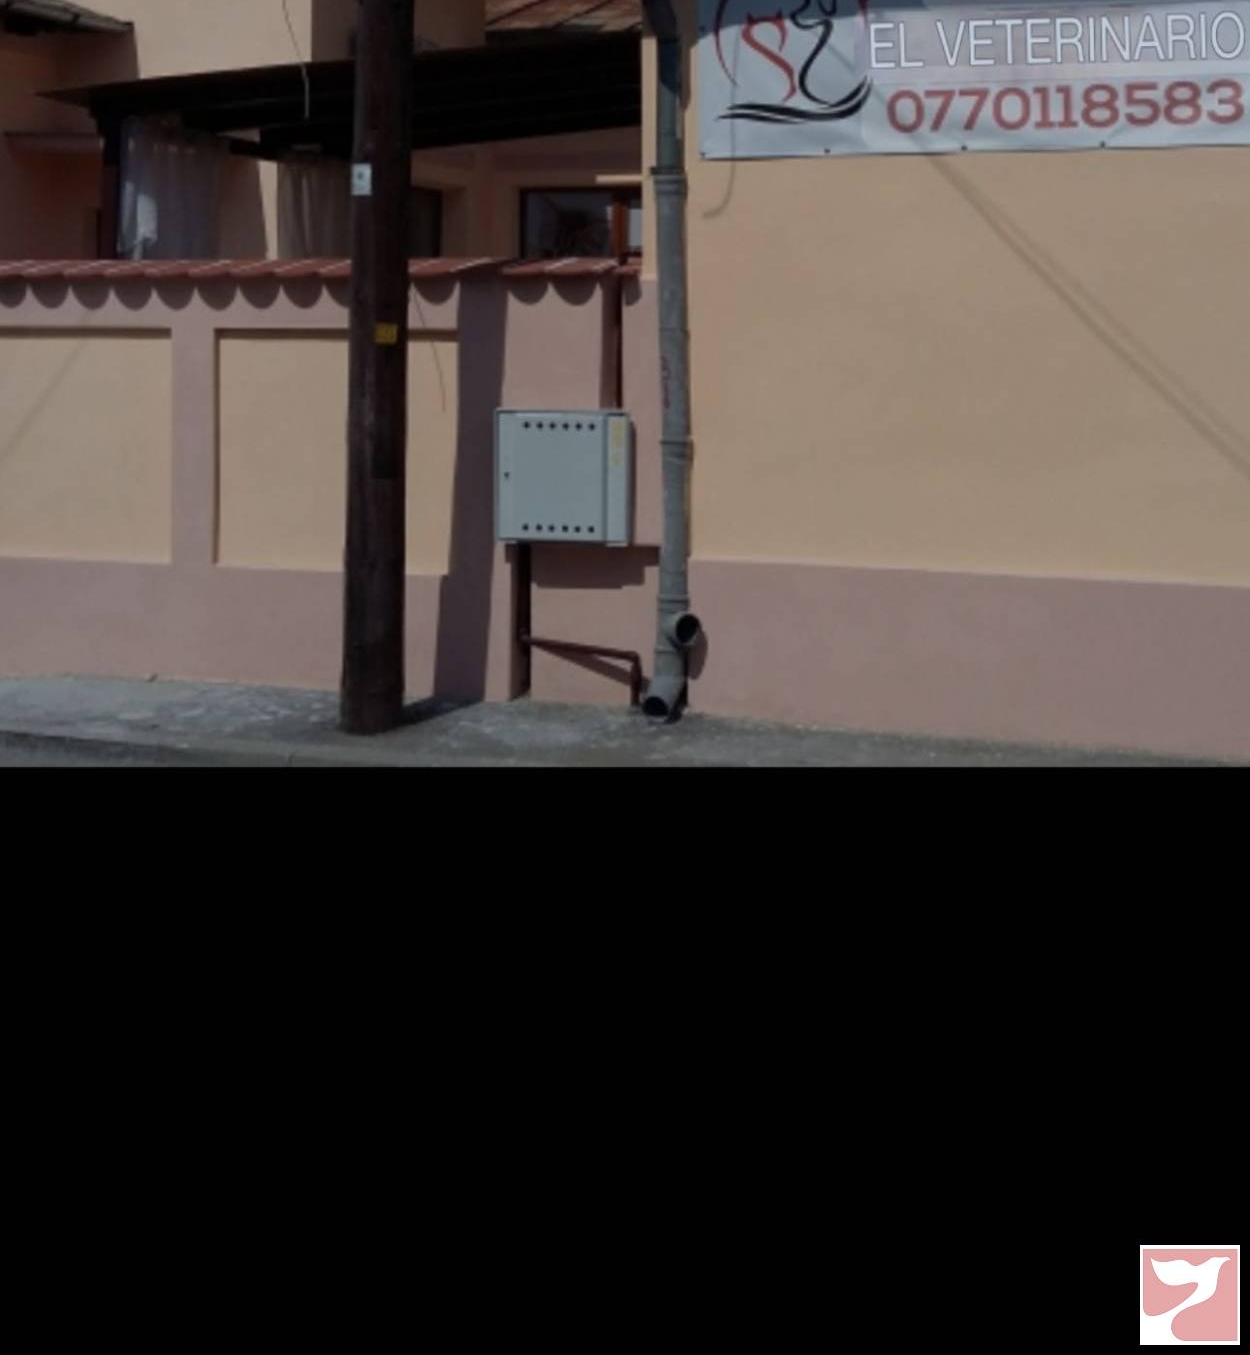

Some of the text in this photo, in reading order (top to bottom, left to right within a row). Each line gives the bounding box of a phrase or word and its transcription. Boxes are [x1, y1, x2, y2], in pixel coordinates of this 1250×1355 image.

[869, 11, 1246, 68] EL VETERINARIO
[886, 78, 1245, 134] 0770118583
